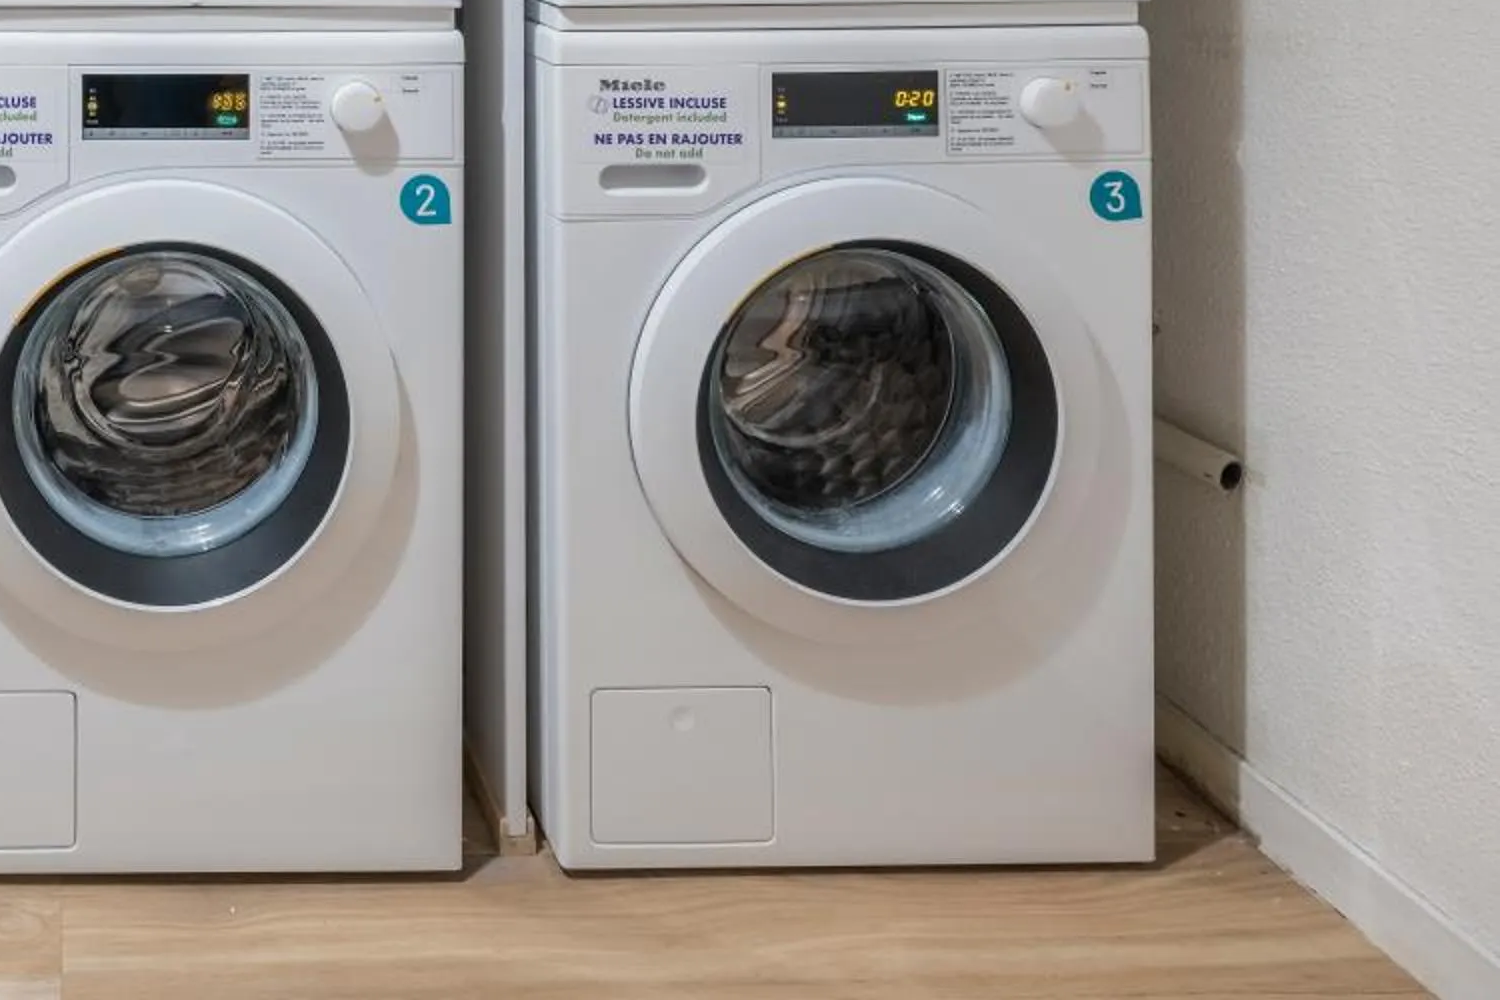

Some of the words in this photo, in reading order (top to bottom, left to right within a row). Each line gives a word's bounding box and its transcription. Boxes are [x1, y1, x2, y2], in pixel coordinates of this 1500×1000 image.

[599, 79, 666, 92] Miele
[613, 97, 665, 109] LESSIVE
[670, 97, 727, 109] INCLUSE
[613, 112, 673, 124] Detergent
[676, 111, 727, 122] included
[594, 133, 612, 145] NE
[618, 133, 644, 145] PAS
[649, 133, 667, 145] EN
[672, 133, 743, 145] RAJOUTER
[635, 148, 651, 158] Do
[656, 148, 675, 158] not
[679, 148, 703, 158] add
[415, 183, 437, 217] 2
[1104, 181, 1126, 213] 3
